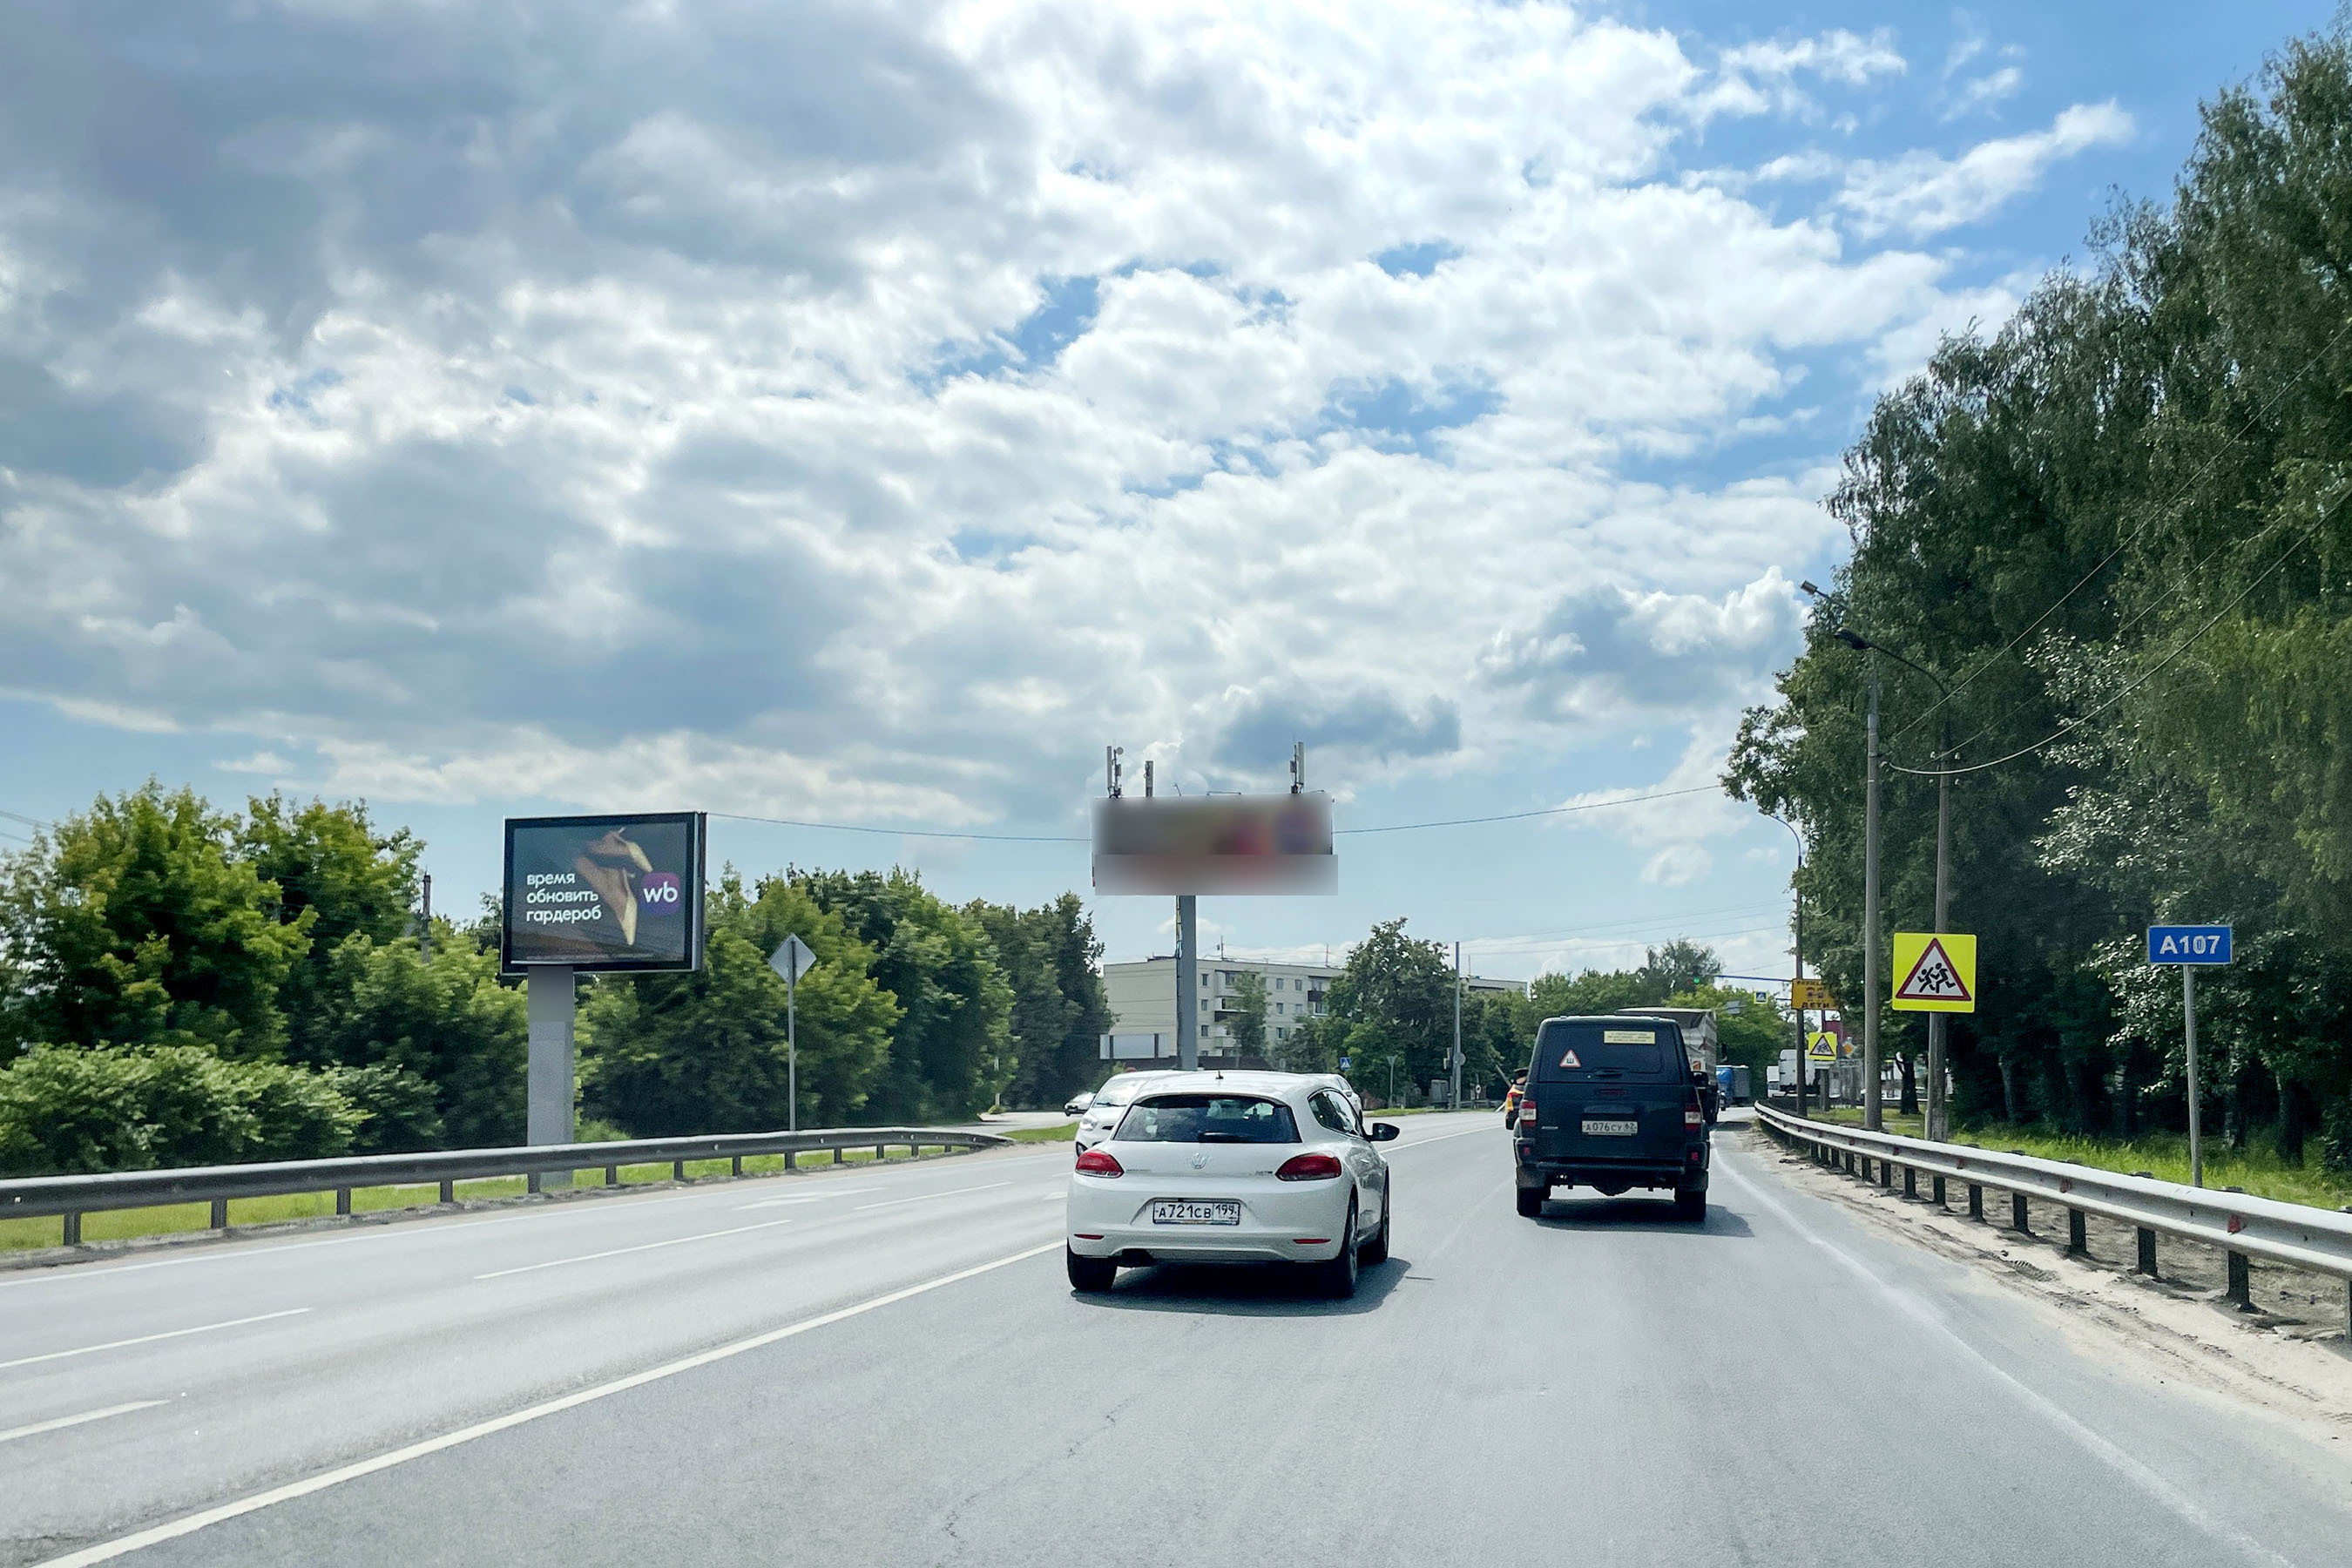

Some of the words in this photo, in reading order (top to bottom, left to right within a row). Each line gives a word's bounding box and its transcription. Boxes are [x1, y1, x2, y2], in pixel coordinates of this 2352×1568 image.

[526, 873, 576, 889] время
[526, 889, 599, 904] обновить
[643, 880, 679, 903] wb
[526, 904, 602, 925] гардероб
[2159, 935, 2220, 955] А107
